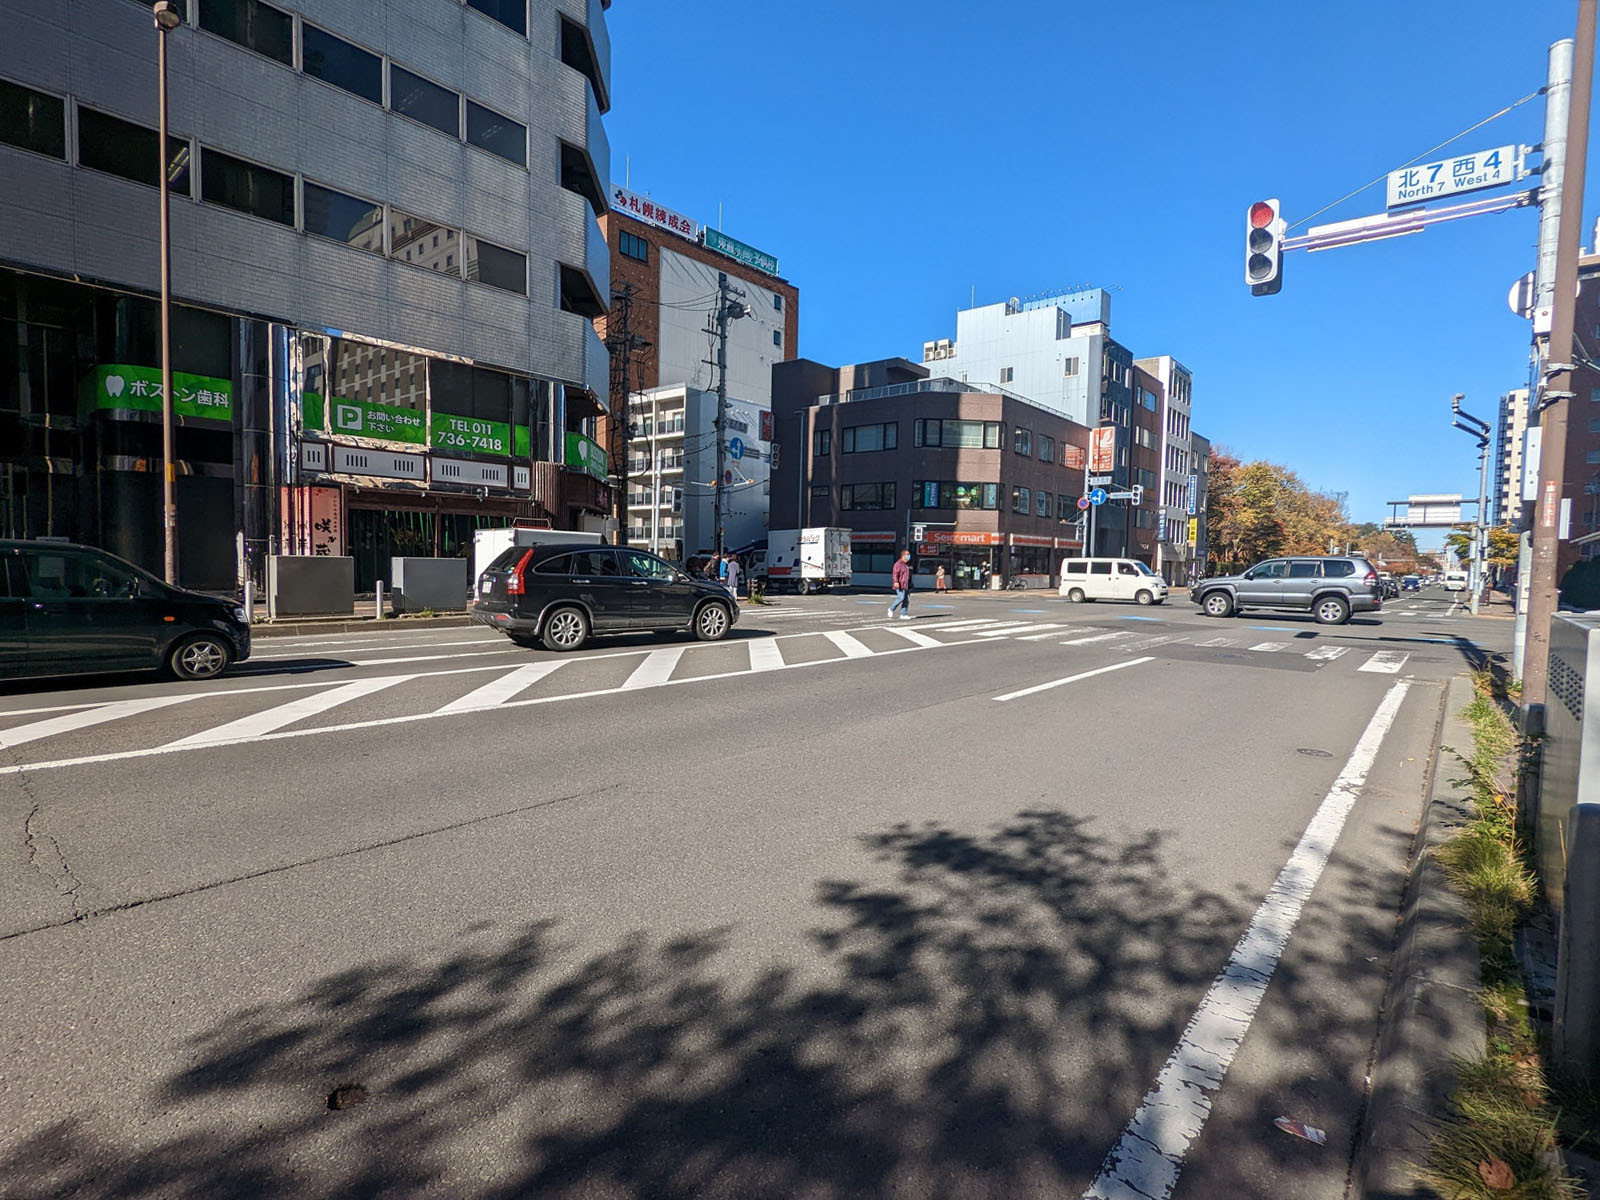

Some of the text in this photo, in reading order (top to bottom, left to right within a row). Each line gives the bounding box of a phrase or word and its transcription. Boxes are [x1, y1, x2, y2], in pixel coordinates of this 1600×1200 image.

[1398, 169, 1500, 199] North 7 West 4
[342, 407, 358, 426] P
[367, 410, 421, 427] お問い合わせ
[367, 422, 395, 433] 下さい
[450, 418, 492, 435] TEL 011
[437, 431, 502, 451] 736-7418
